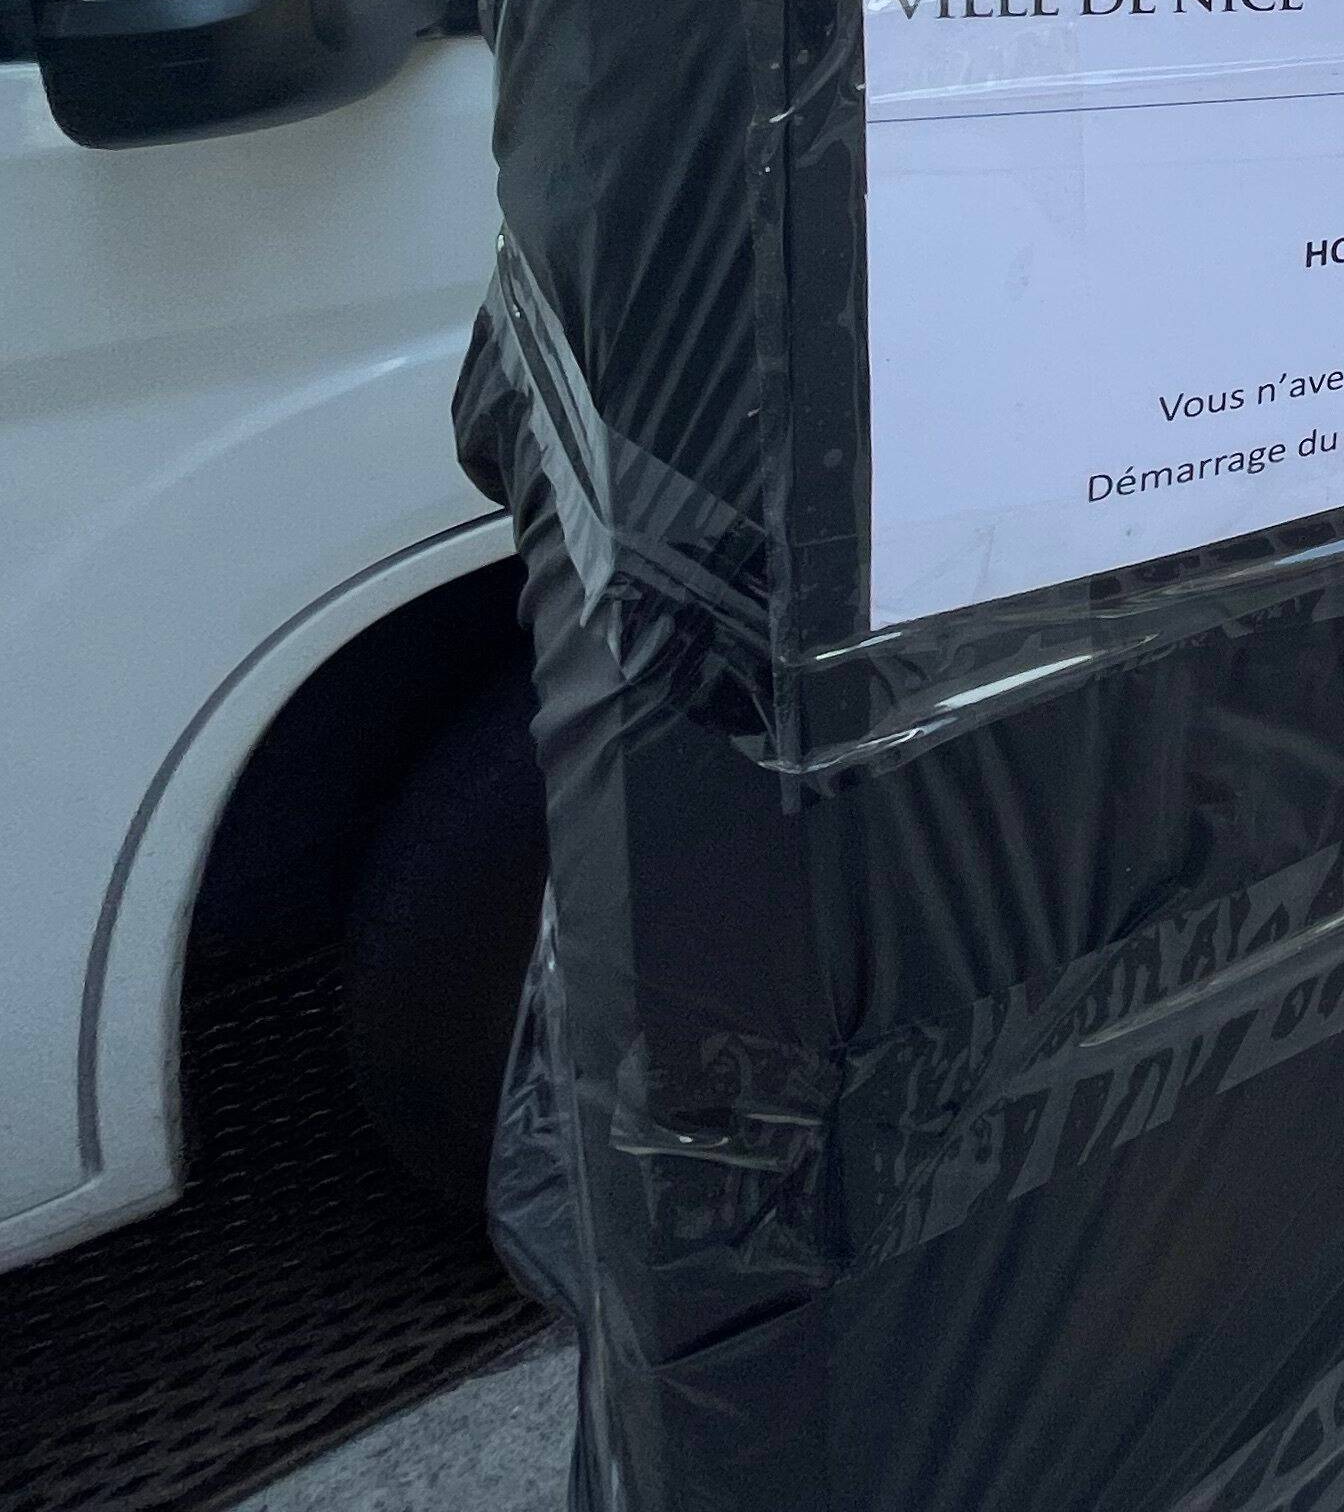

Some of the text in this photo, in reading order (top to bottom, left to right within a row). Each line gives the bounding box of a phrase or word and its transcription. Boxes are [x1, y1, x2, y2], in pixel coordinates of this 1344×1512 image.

[1158, 388, 1245, 422] Vous
[1088, 443, 1287, 504] Démarrage
[1298, 428, 1338, 458] du
